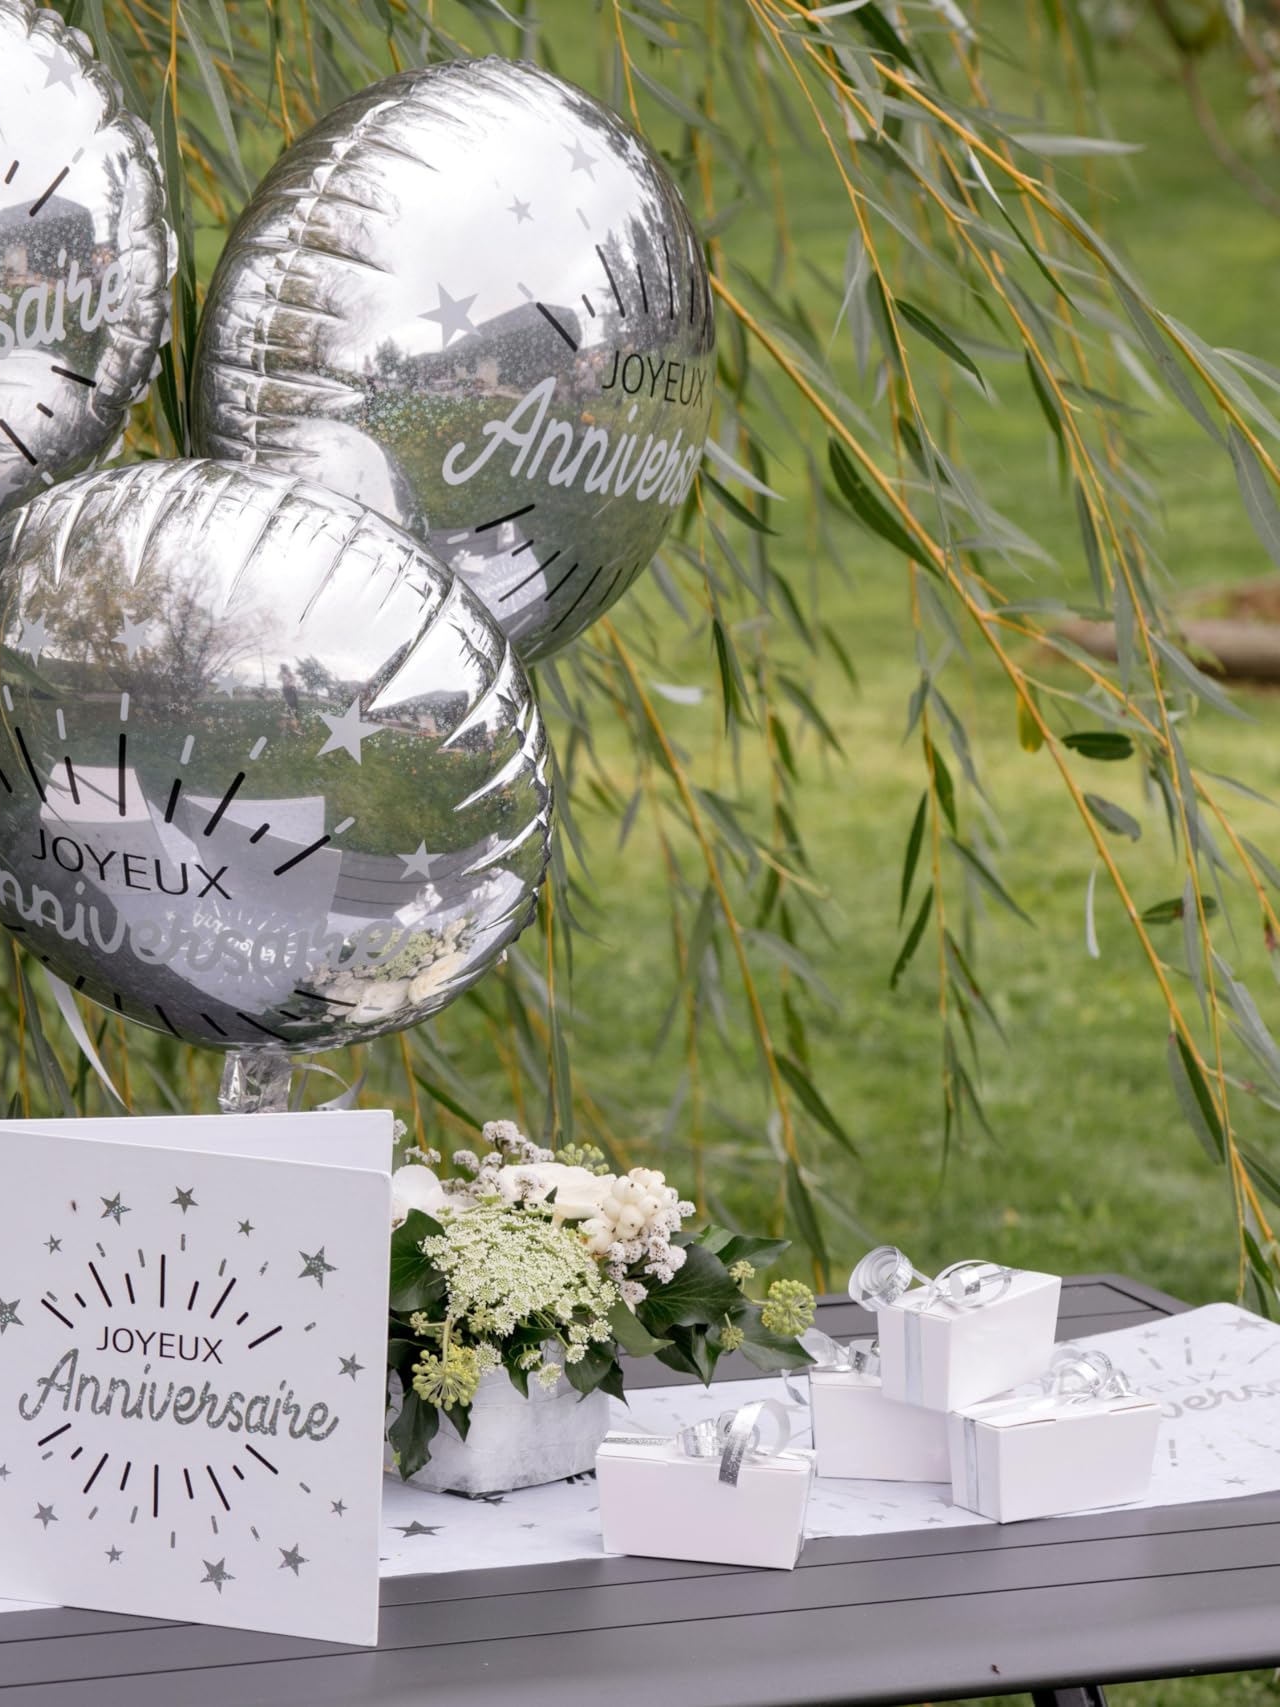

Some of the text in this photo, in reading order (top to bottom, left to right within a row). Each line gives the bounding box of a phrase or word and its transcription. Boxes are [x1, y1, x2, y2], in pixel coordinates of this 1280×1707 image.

[601, 349, 707, 409] JOYEUX
[31, 828, 233, 900] JOYEUX
[95, 1325, 224, 1365] JOYEUX
[19, 1348, 341, 1442] Anniversaire
